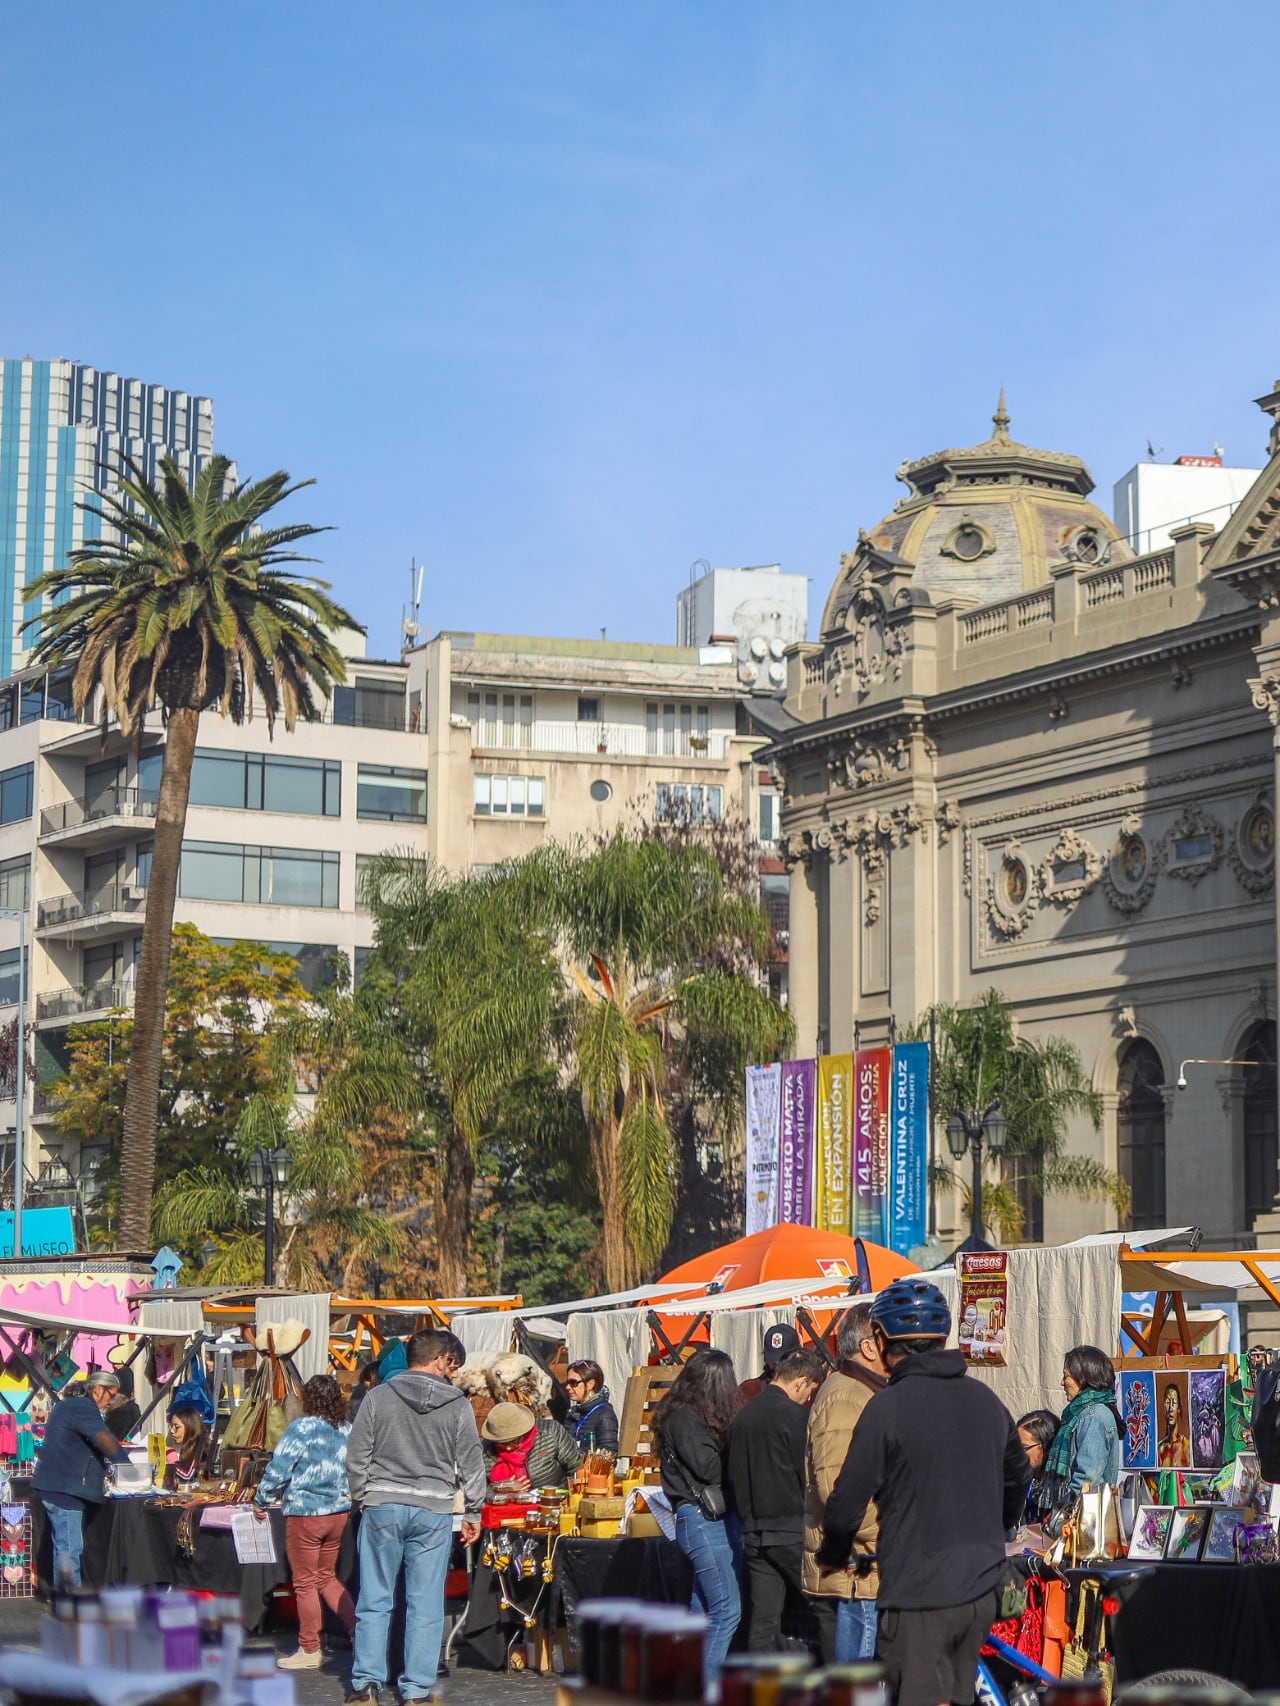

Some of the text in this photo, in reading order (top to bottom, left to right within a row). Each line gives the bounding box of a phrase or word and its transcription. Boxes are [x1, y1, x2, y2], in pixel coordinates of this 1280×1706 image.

[784, 1074, 794, 1136] MATTA
[796, 1073, 805, 1143] MIRADA
[858, 1064, 872, 1139] AÑOS:
[897, 1059, 907, 1112] CRUZ
[796, 1148, 804, 1170] LA
[831, 1073, 843, 1225] EN EXPANSIÓN
[858, 1149, 871, 1197] 145
[871, 1124, 880, 1196] HISTORIAS
[878, 1112, 888, 1196] COLECCIÓN
[895, 1115, 907, 1220] VALENTINA
[907, 1207, 914, 1221] DE
[21, 1241, 69, 1257] MUSEO
